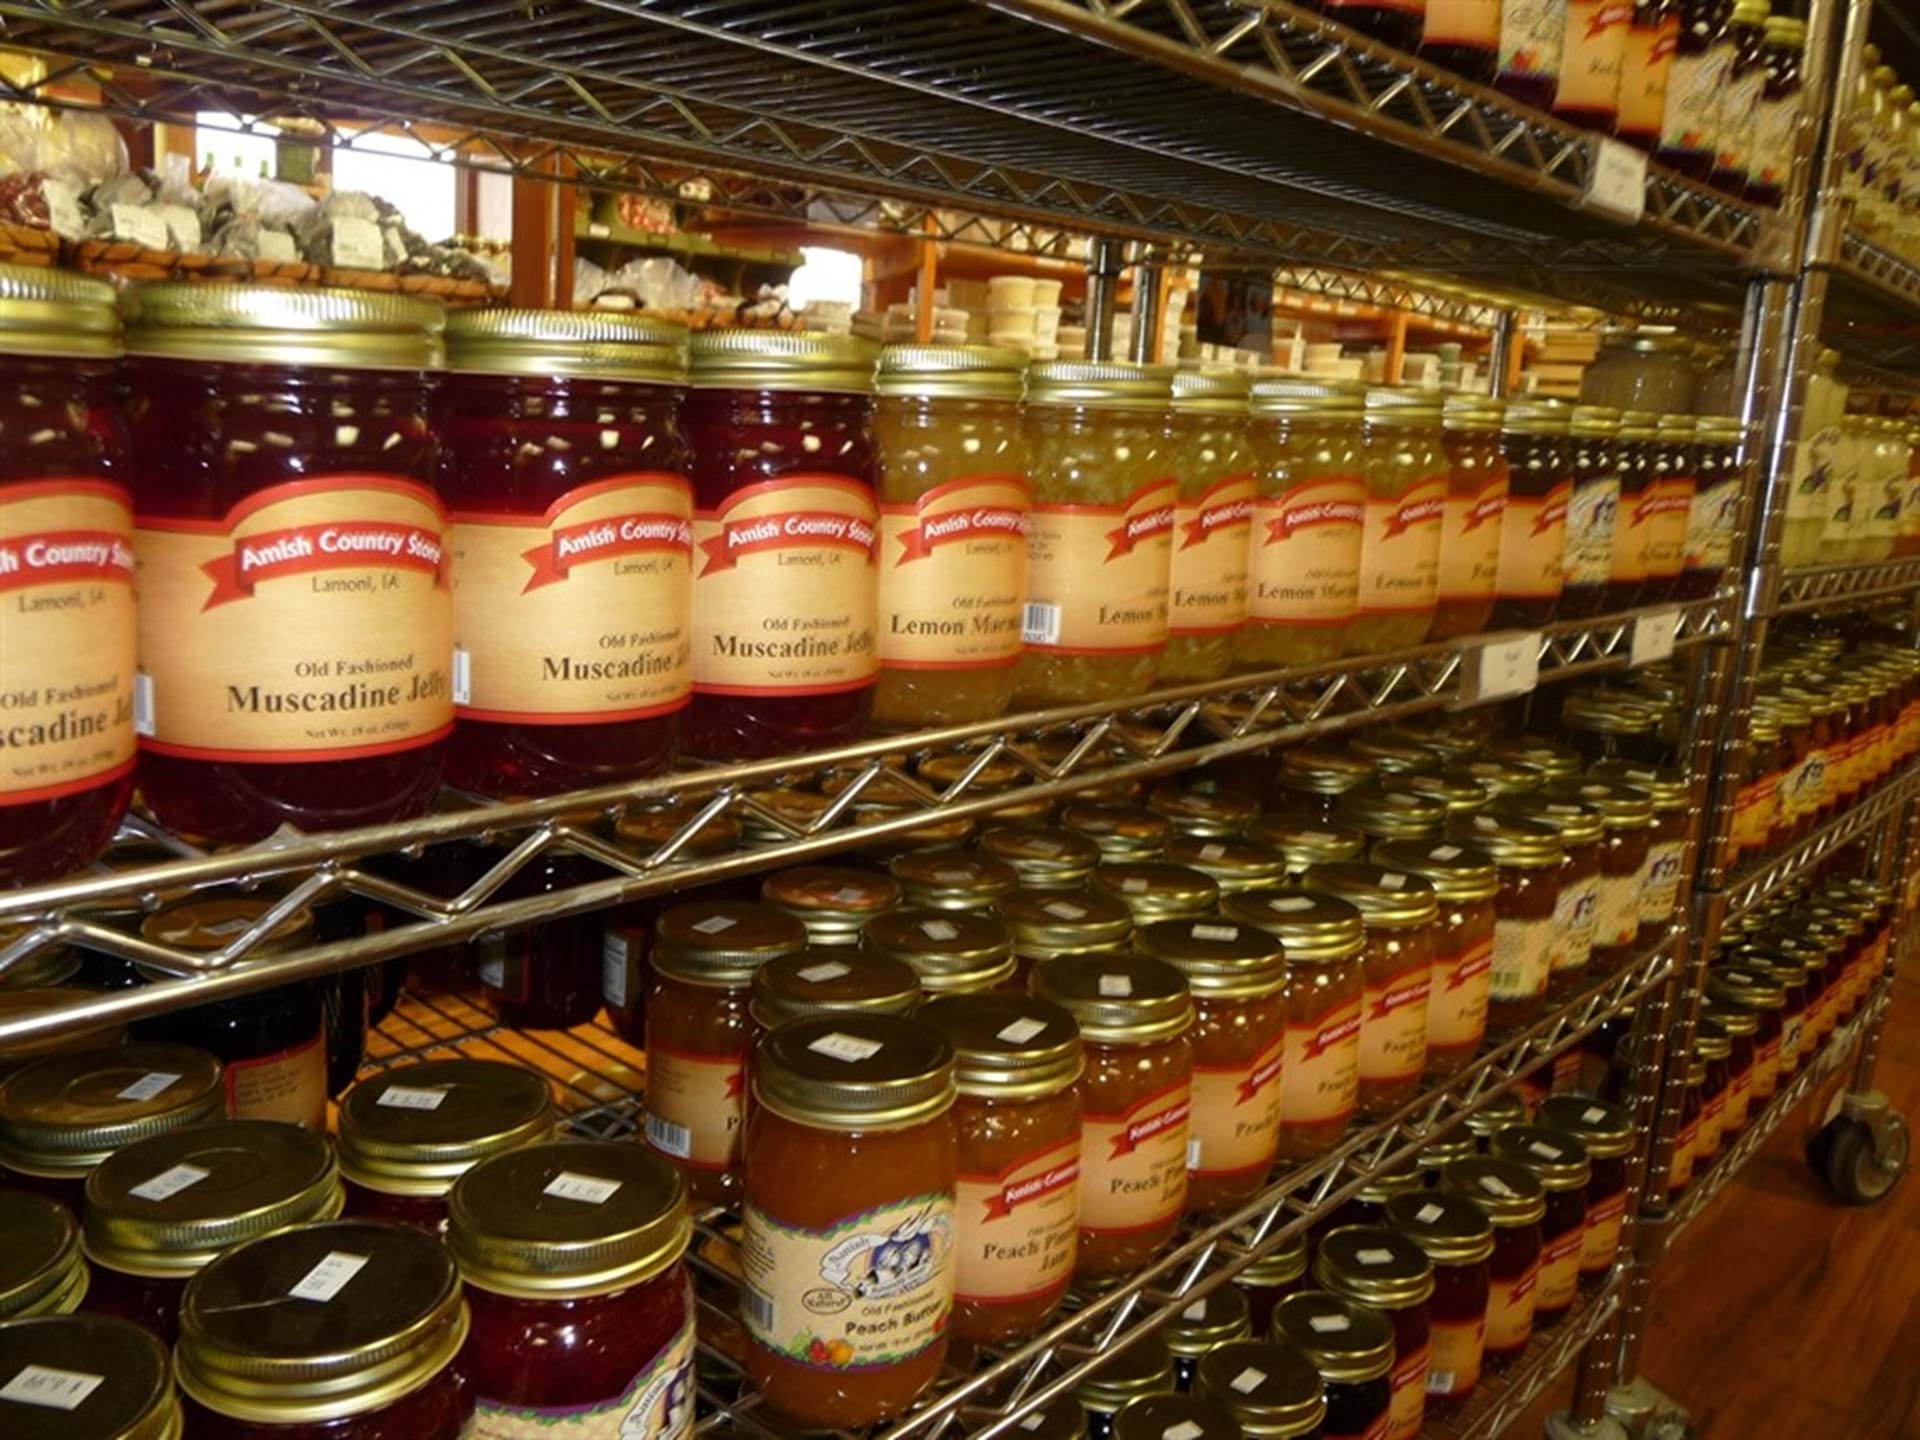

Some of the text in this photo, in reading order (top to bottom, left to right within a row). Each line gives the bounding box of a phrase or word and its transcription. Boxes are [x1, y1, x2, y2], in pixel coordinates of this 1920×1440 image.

[728, 521, 780, 549] Amish
[784, 516, 846, 539] Country
[925, 513, 969, 539] Amish
[559, 523, 616, 558] Amish
[620, 518, 678, 542] Country
[25, 541, 109, 568] Country
[242, 529, 442, 571] Amish Country Store
[382, 574, 400, 590] IA
[1257, 580, 1316, 600] Lemon
[1174, 589, 1230, 608] Lemon
[763, 618, 788, 631] Old
[1099, 604, 1154, 625] Lemon
[891, 615, 964, 636] Lemon
[712, 634, 839, 659] Muscadine
[295, 654, 413, 677] Old Fashioned
[543, 652, 673, 681] Muscadine
[0, 689, 38, 710] Old
[227, 683, 400, 713] Muscadine
[1110, 1174, 1160, 1195] Peach
[983, 1240, 1039, 1260] Peach
[845, 1318, 899, 1336] Peach
